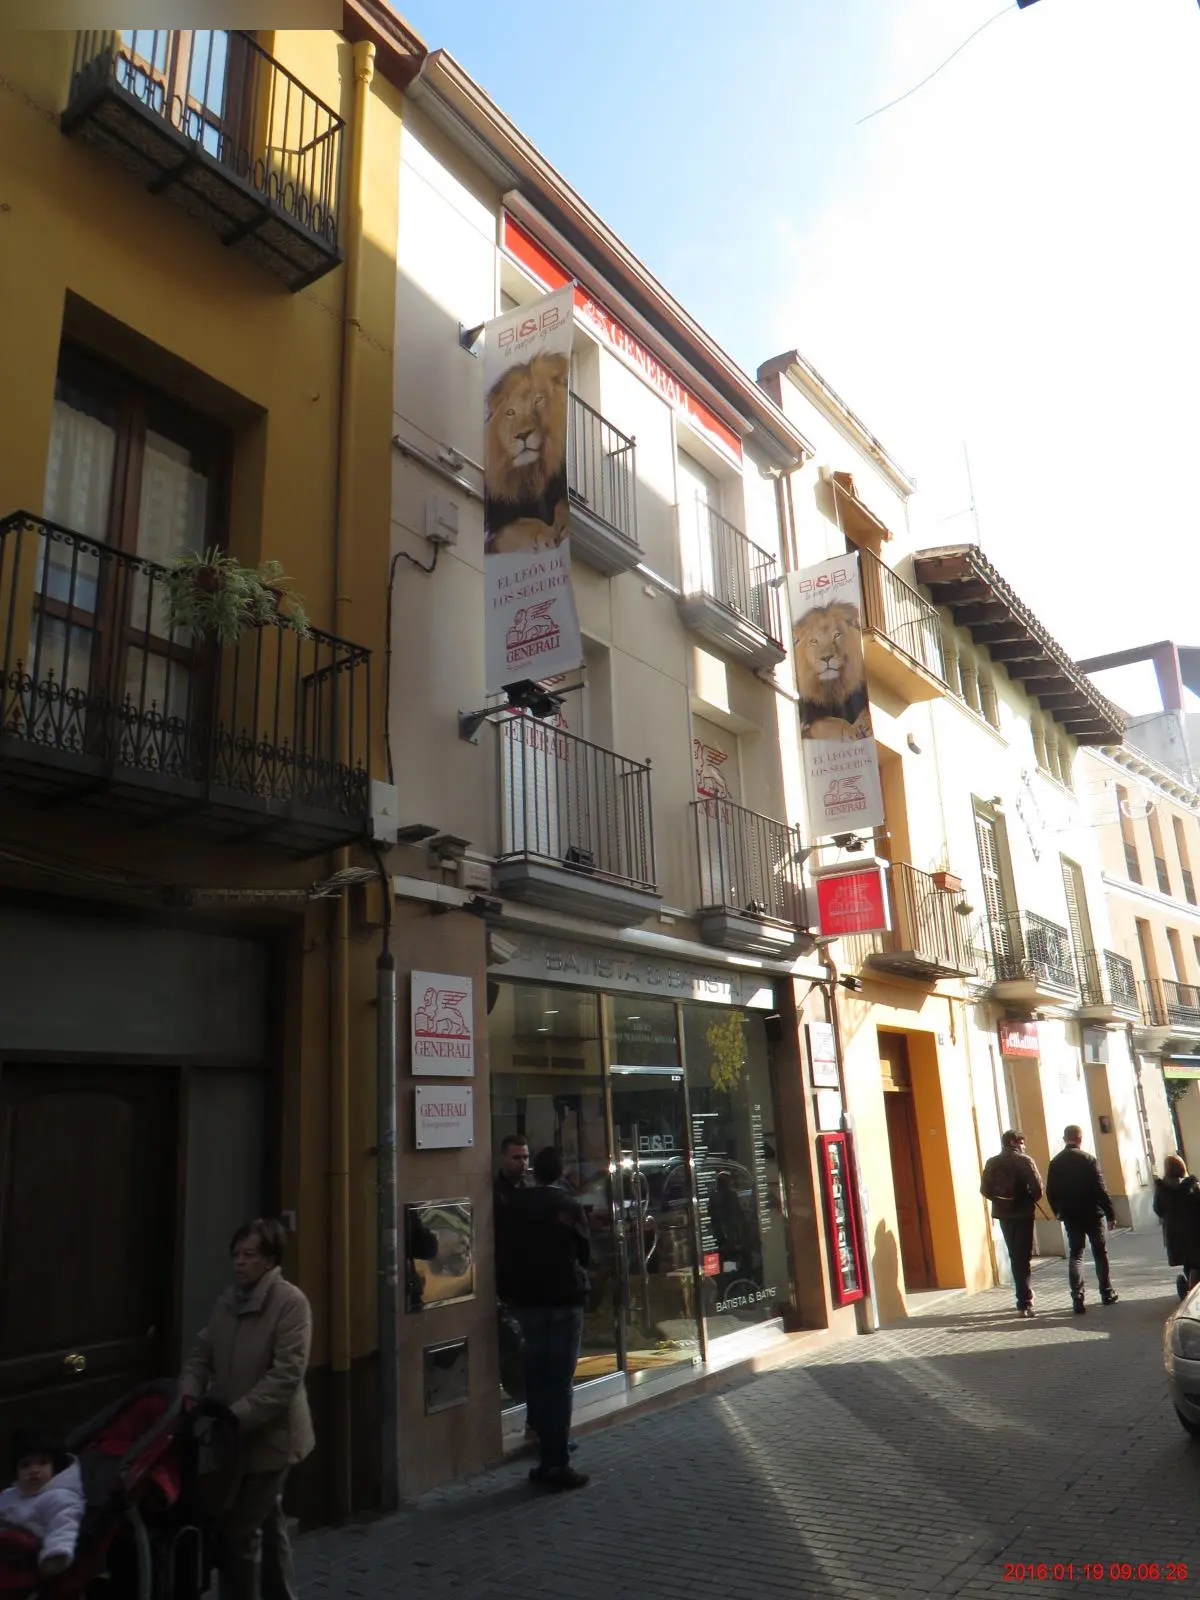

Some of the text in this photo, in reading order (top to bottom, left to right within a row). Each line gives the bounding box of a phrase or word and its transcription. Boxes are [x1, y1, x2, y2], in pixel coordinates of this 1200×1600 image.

[497, 575, 511, 590] EL
[550, 556, 565, 571] DE
[493, 595, 513, 610] LOS
[506, 635, 560, 664] GENERALI
[814, 756, 825, 766] EL
[854, 745, 865, 756] DE
[811, 756, 873, 777] LOS SEGUROS
[824, 801, 867, 816] GENERALI
[545, 950, 738, 996] BATISTA & BATISTA
[415, 1041, 470, 1058] GENERALI
[420, 1103, 466, 1117] GENERALI
[716, 1296, 747, 1312] BATISTA
[748, 1293, 755, 1303] &
